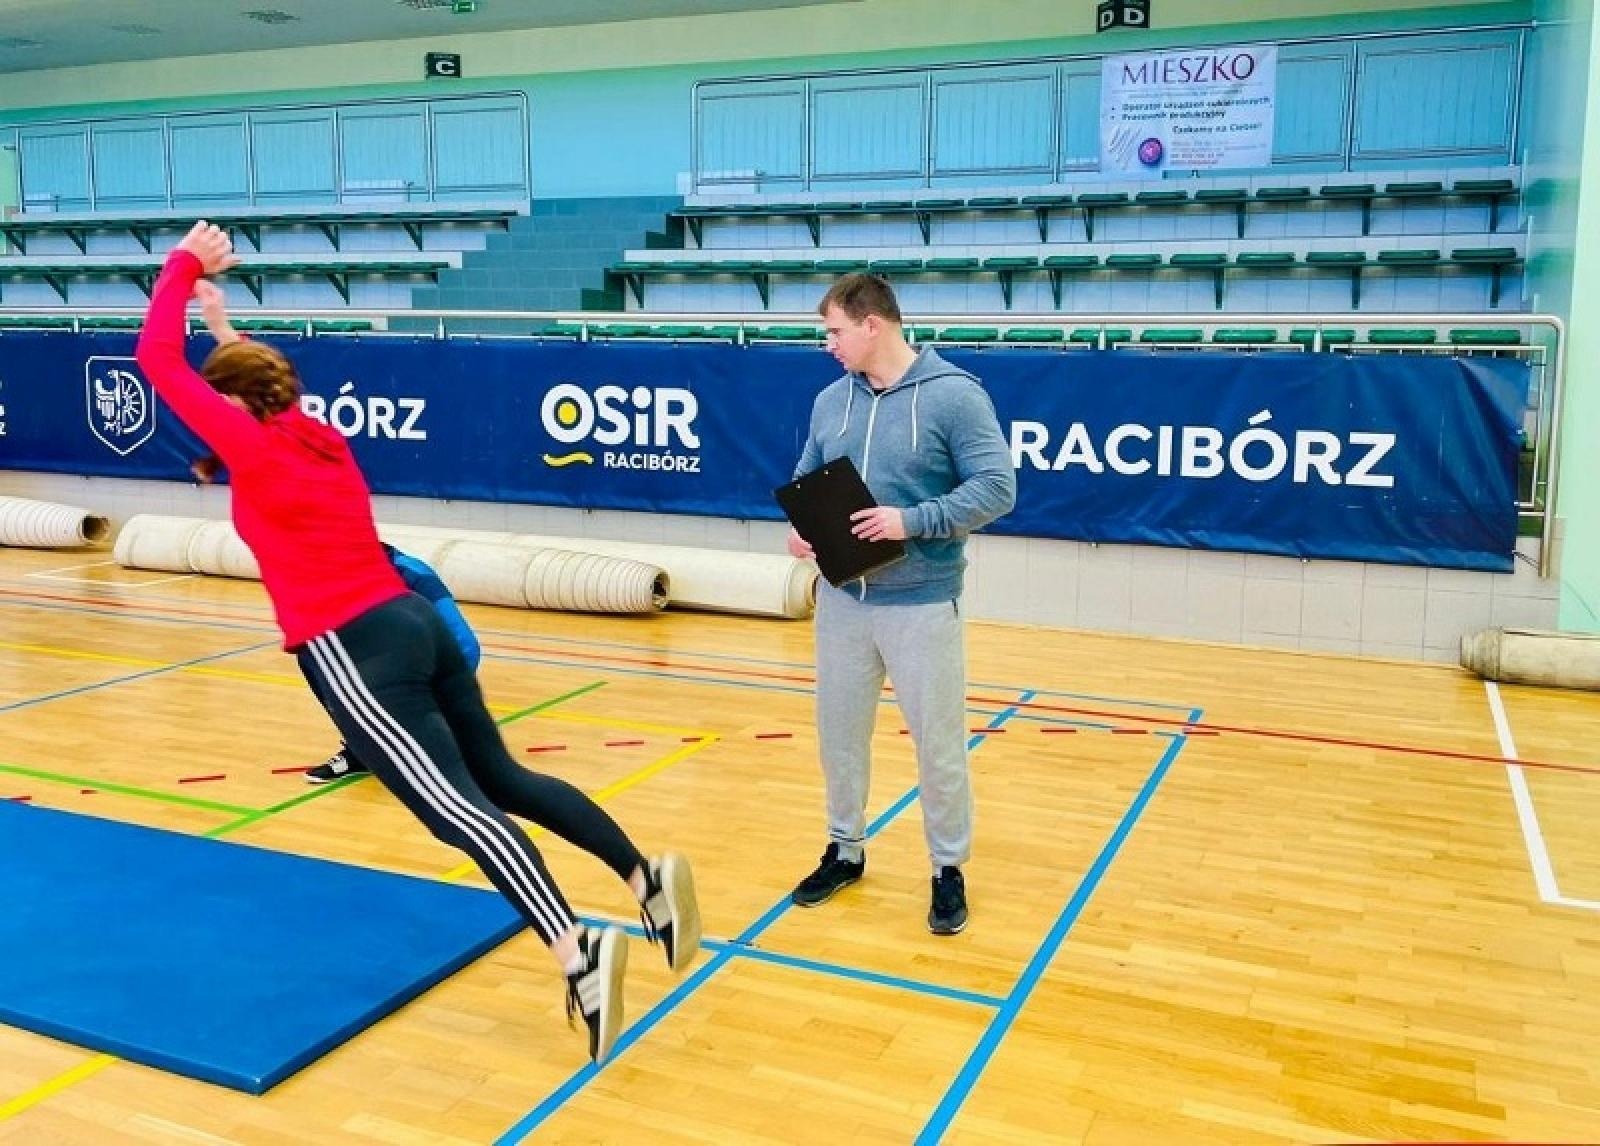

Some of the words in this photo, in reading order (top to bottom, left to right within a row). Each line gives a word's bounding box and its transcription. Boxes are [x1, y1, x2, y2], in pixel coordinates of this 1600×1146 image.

[1101, 10, 1114, 28] D
[1124, 8, 1145, 24] D
[435, 60, 455, 75] C
[1122, 53, 1255, 85] MIESZKO
[300, 381, 427, 440] BÓRZ
[540, 383, 701, 449] OSiR
[603, 450, 701, 473] RACIBÓRZ
[1010, 409, 1397, 488] RACIBÓRZ
